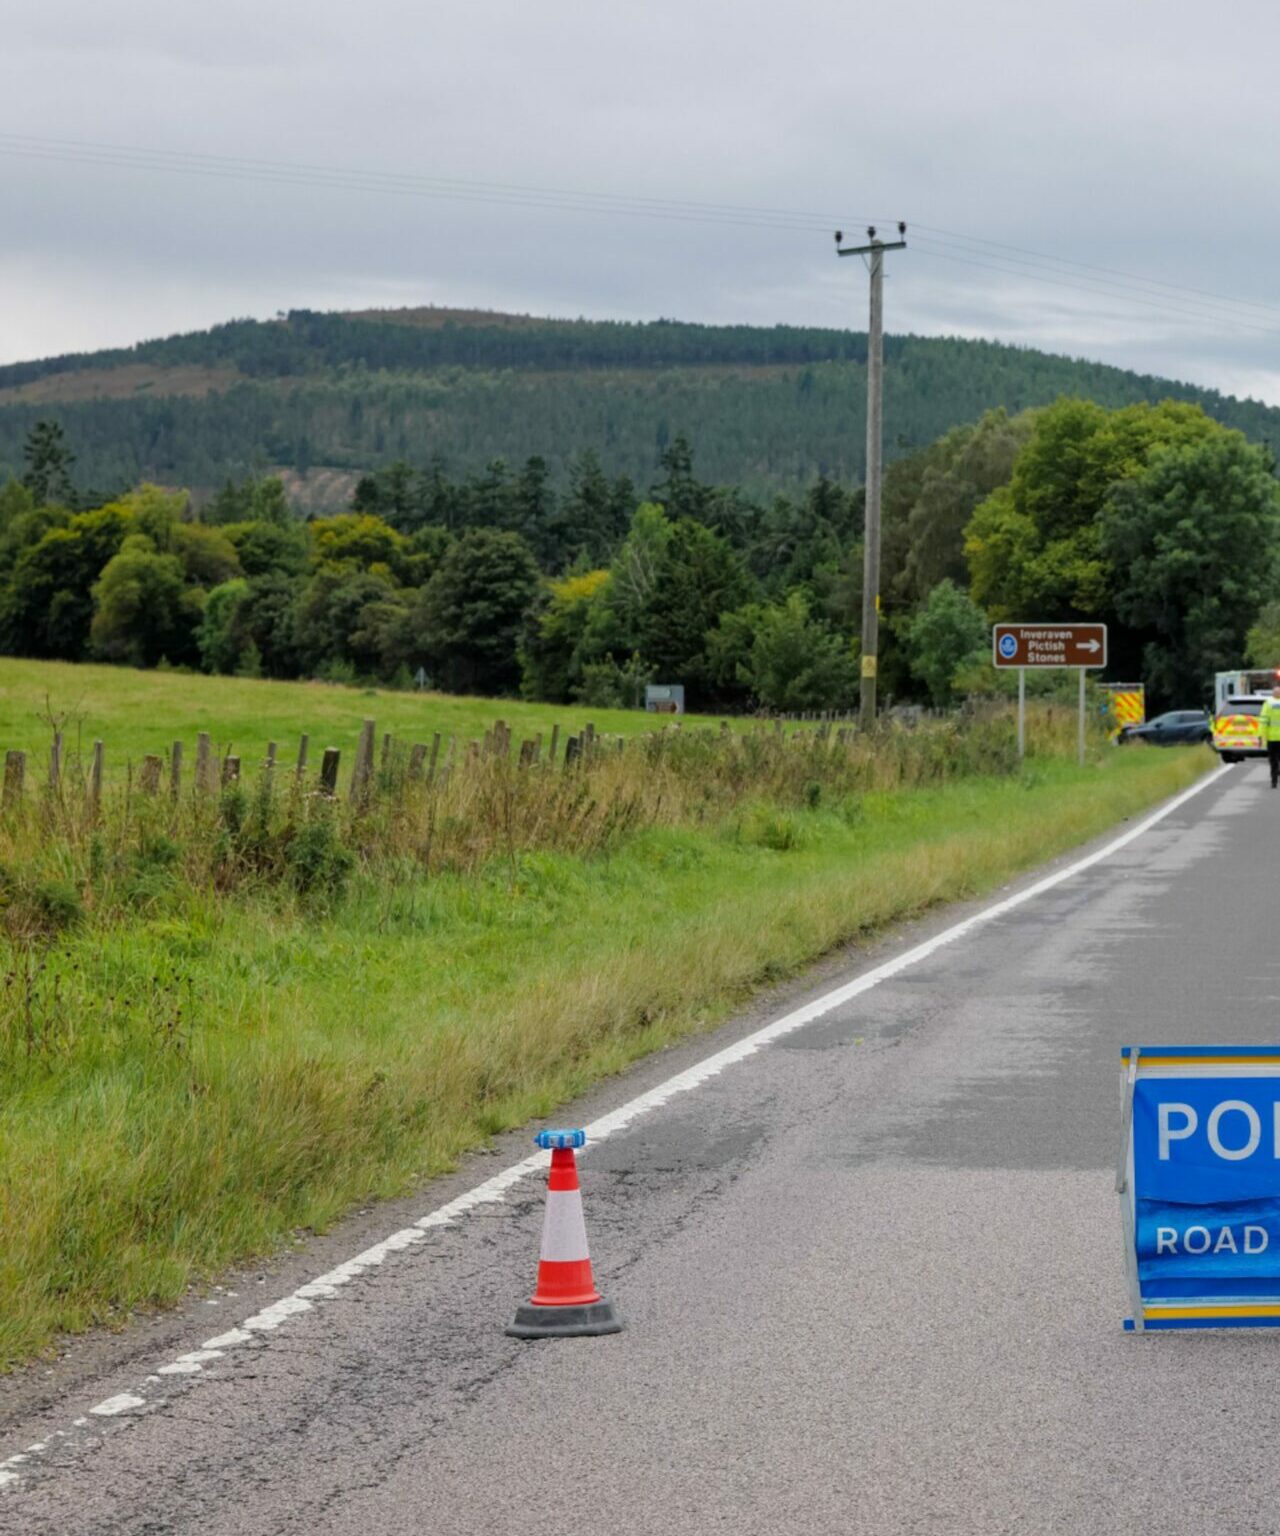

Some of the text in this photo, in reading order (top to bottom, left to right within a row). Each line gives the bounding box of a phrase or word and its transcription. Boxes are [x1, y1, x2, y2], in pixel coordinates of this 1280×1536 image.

[1020, 629, 1073, 639] Inveraven
[1028, 641, 1065, 650] Pictish
[1028, 652, 1066, 662] Stones
[1156, 1226, 1269, 1255] ROAD
